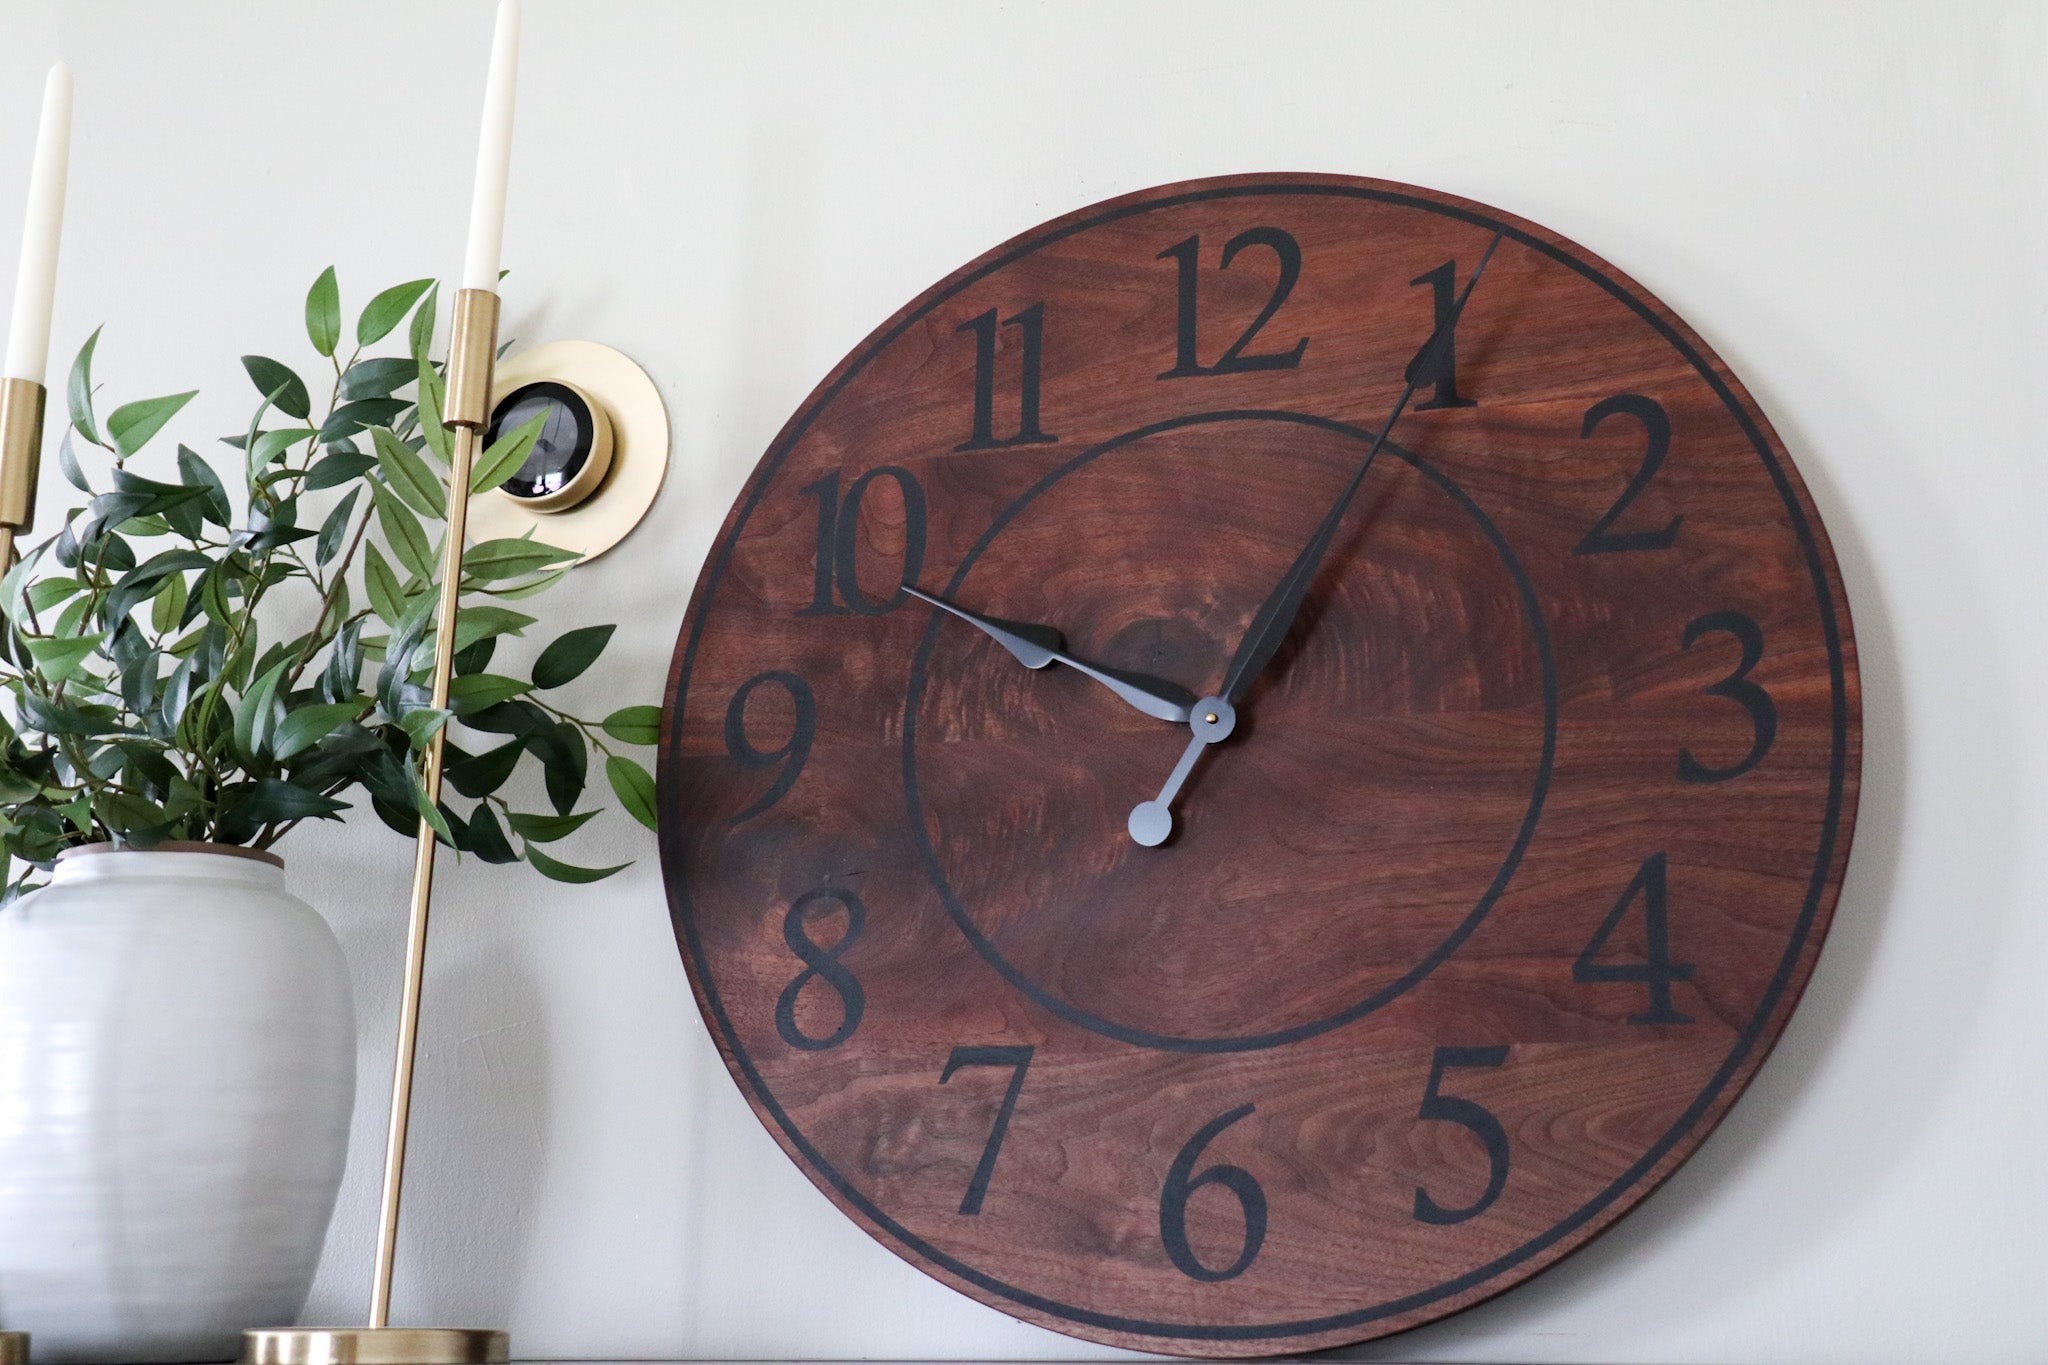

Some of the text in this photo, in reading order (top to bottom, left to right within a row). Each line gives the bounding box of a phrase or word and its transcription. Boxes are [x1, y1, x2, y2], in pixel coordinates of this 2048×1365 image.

[953, 302, 1059, 452] 11
[1155, 226, 1310, 381] 12
[1409, 260, 1478, 412] 1
[793, 466, 928, 618] 10
[1572, 394, 1684, 555] 2
[725, 671, 817, 827] 9
[1676, 611, 1778, 783] 3
[775, 887, 867, 1051] 8
[1572, 851, 1696, 1026] 4
[938, 1045, 1036, 1216] 7
[1160, 1102, 1268, 1282] 6
[1413, 1045, 1511, 1225] 5
